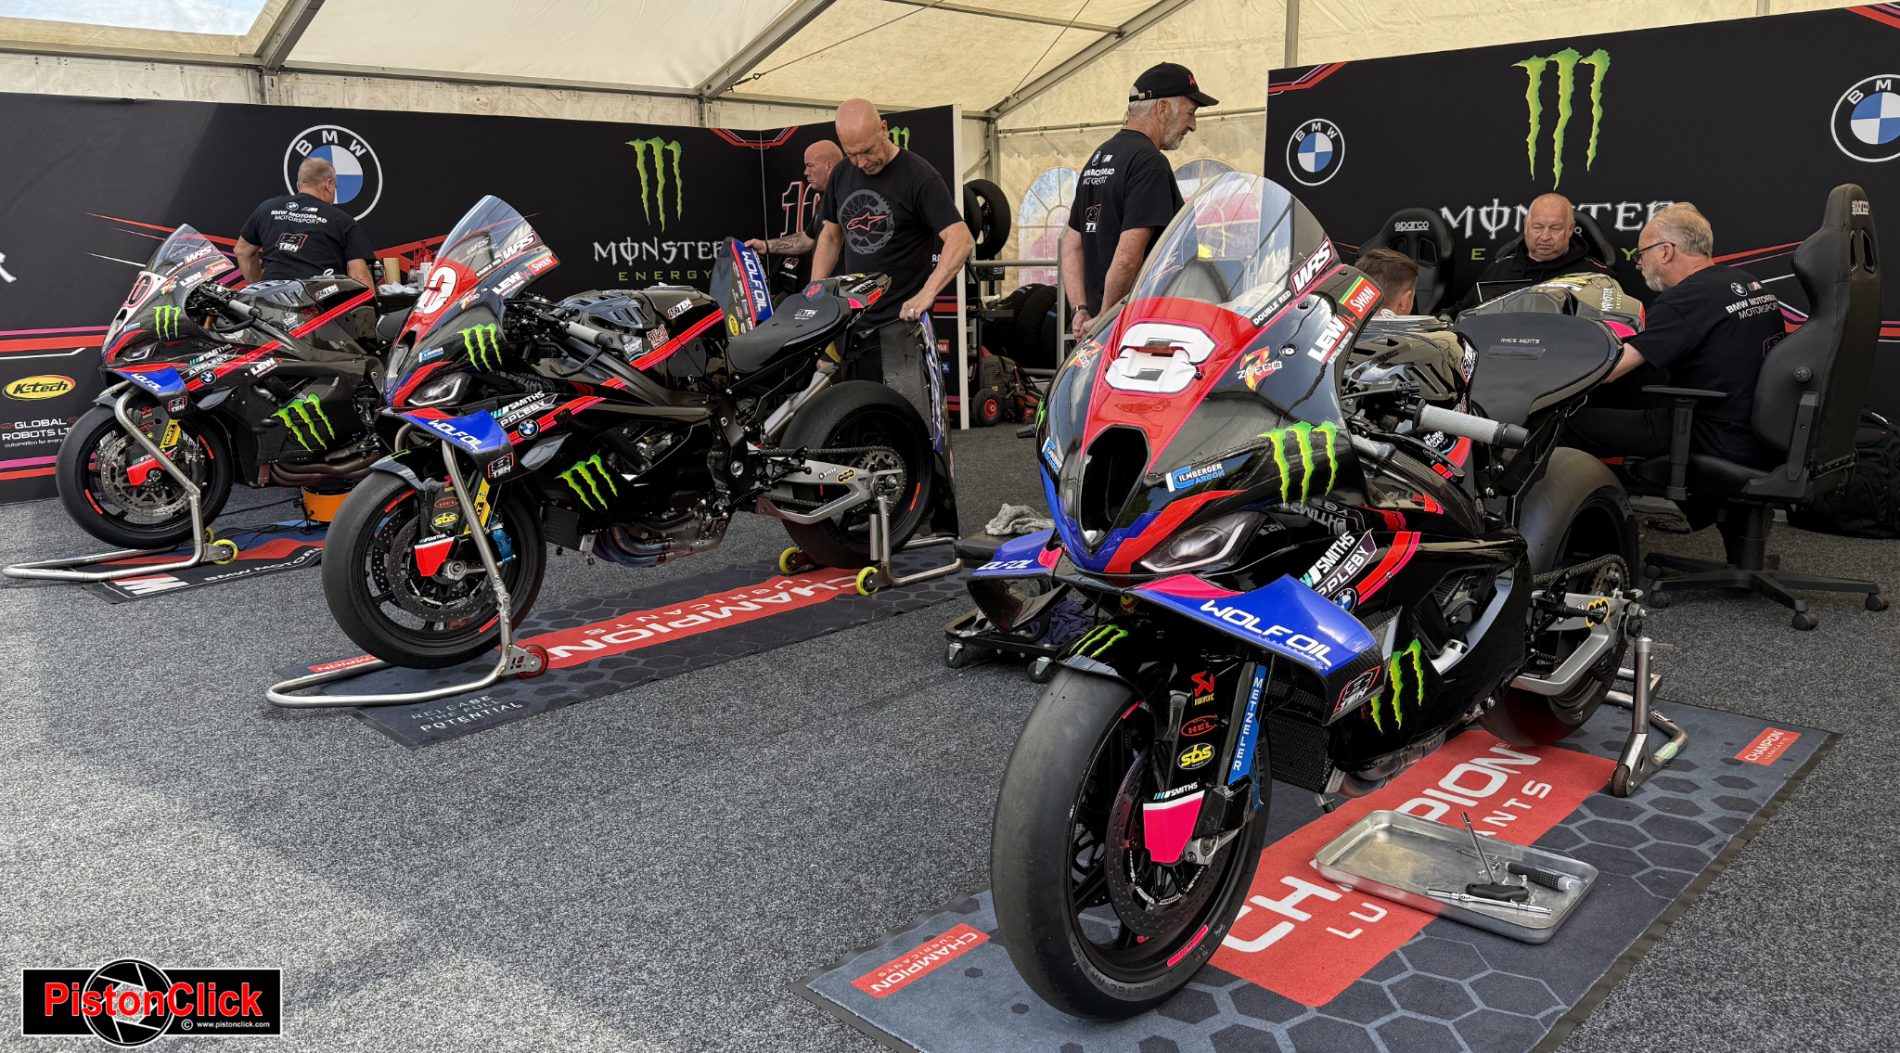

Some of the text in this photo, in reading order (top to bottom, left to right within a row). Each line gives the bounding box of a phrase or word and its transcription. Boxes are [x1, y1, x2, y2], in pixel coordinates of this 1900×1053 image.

[1296, 122, 1337, 141] BMW
[296, 130, 366, 157] BMW
[1394, 220, 1430, 231] sparco
[618, 269, 712, 281] ENERGY
[1293, 240, 1330, 293] WRS
[492, 272, 522, 295] LEW
[1252, 290, 1292, 326] DOUBLE RED
[1350, 286, 1375, 313] SWAN
[1725, 300, 1748, 313] BMW
[1307, 316, 1346, 363] LEW
[509, 390, 546, 410] SMITHS
[2, 429, 55, 441] ROBOTS
[15, 418, 67, 429] GLOBAL
[4, 440, 37, 448] automation
[1179, 463, 1223, 482] ILMBERGER
[435, 512, 458, 525] sbs
[254, 547, 323, 571] MOTOR
[1315, 530, 1356, 573] SMITHS
[546, 576, 858, 658] CHAMPION
[420, 702, 523, 732] POTENTIAL
[1188, 721, 1213, 734] HEL
[1233, 677, 1263, 771] METZELER
[1181, 744, 1213, 767] sbs
[1170, 782, 1198, 797] SMITHS
[1221, 746, 1543, 953] CHPION
[870, 932, 979, 992] CHAMPION
[878, 935, 954, 977] LUBRICANTS
